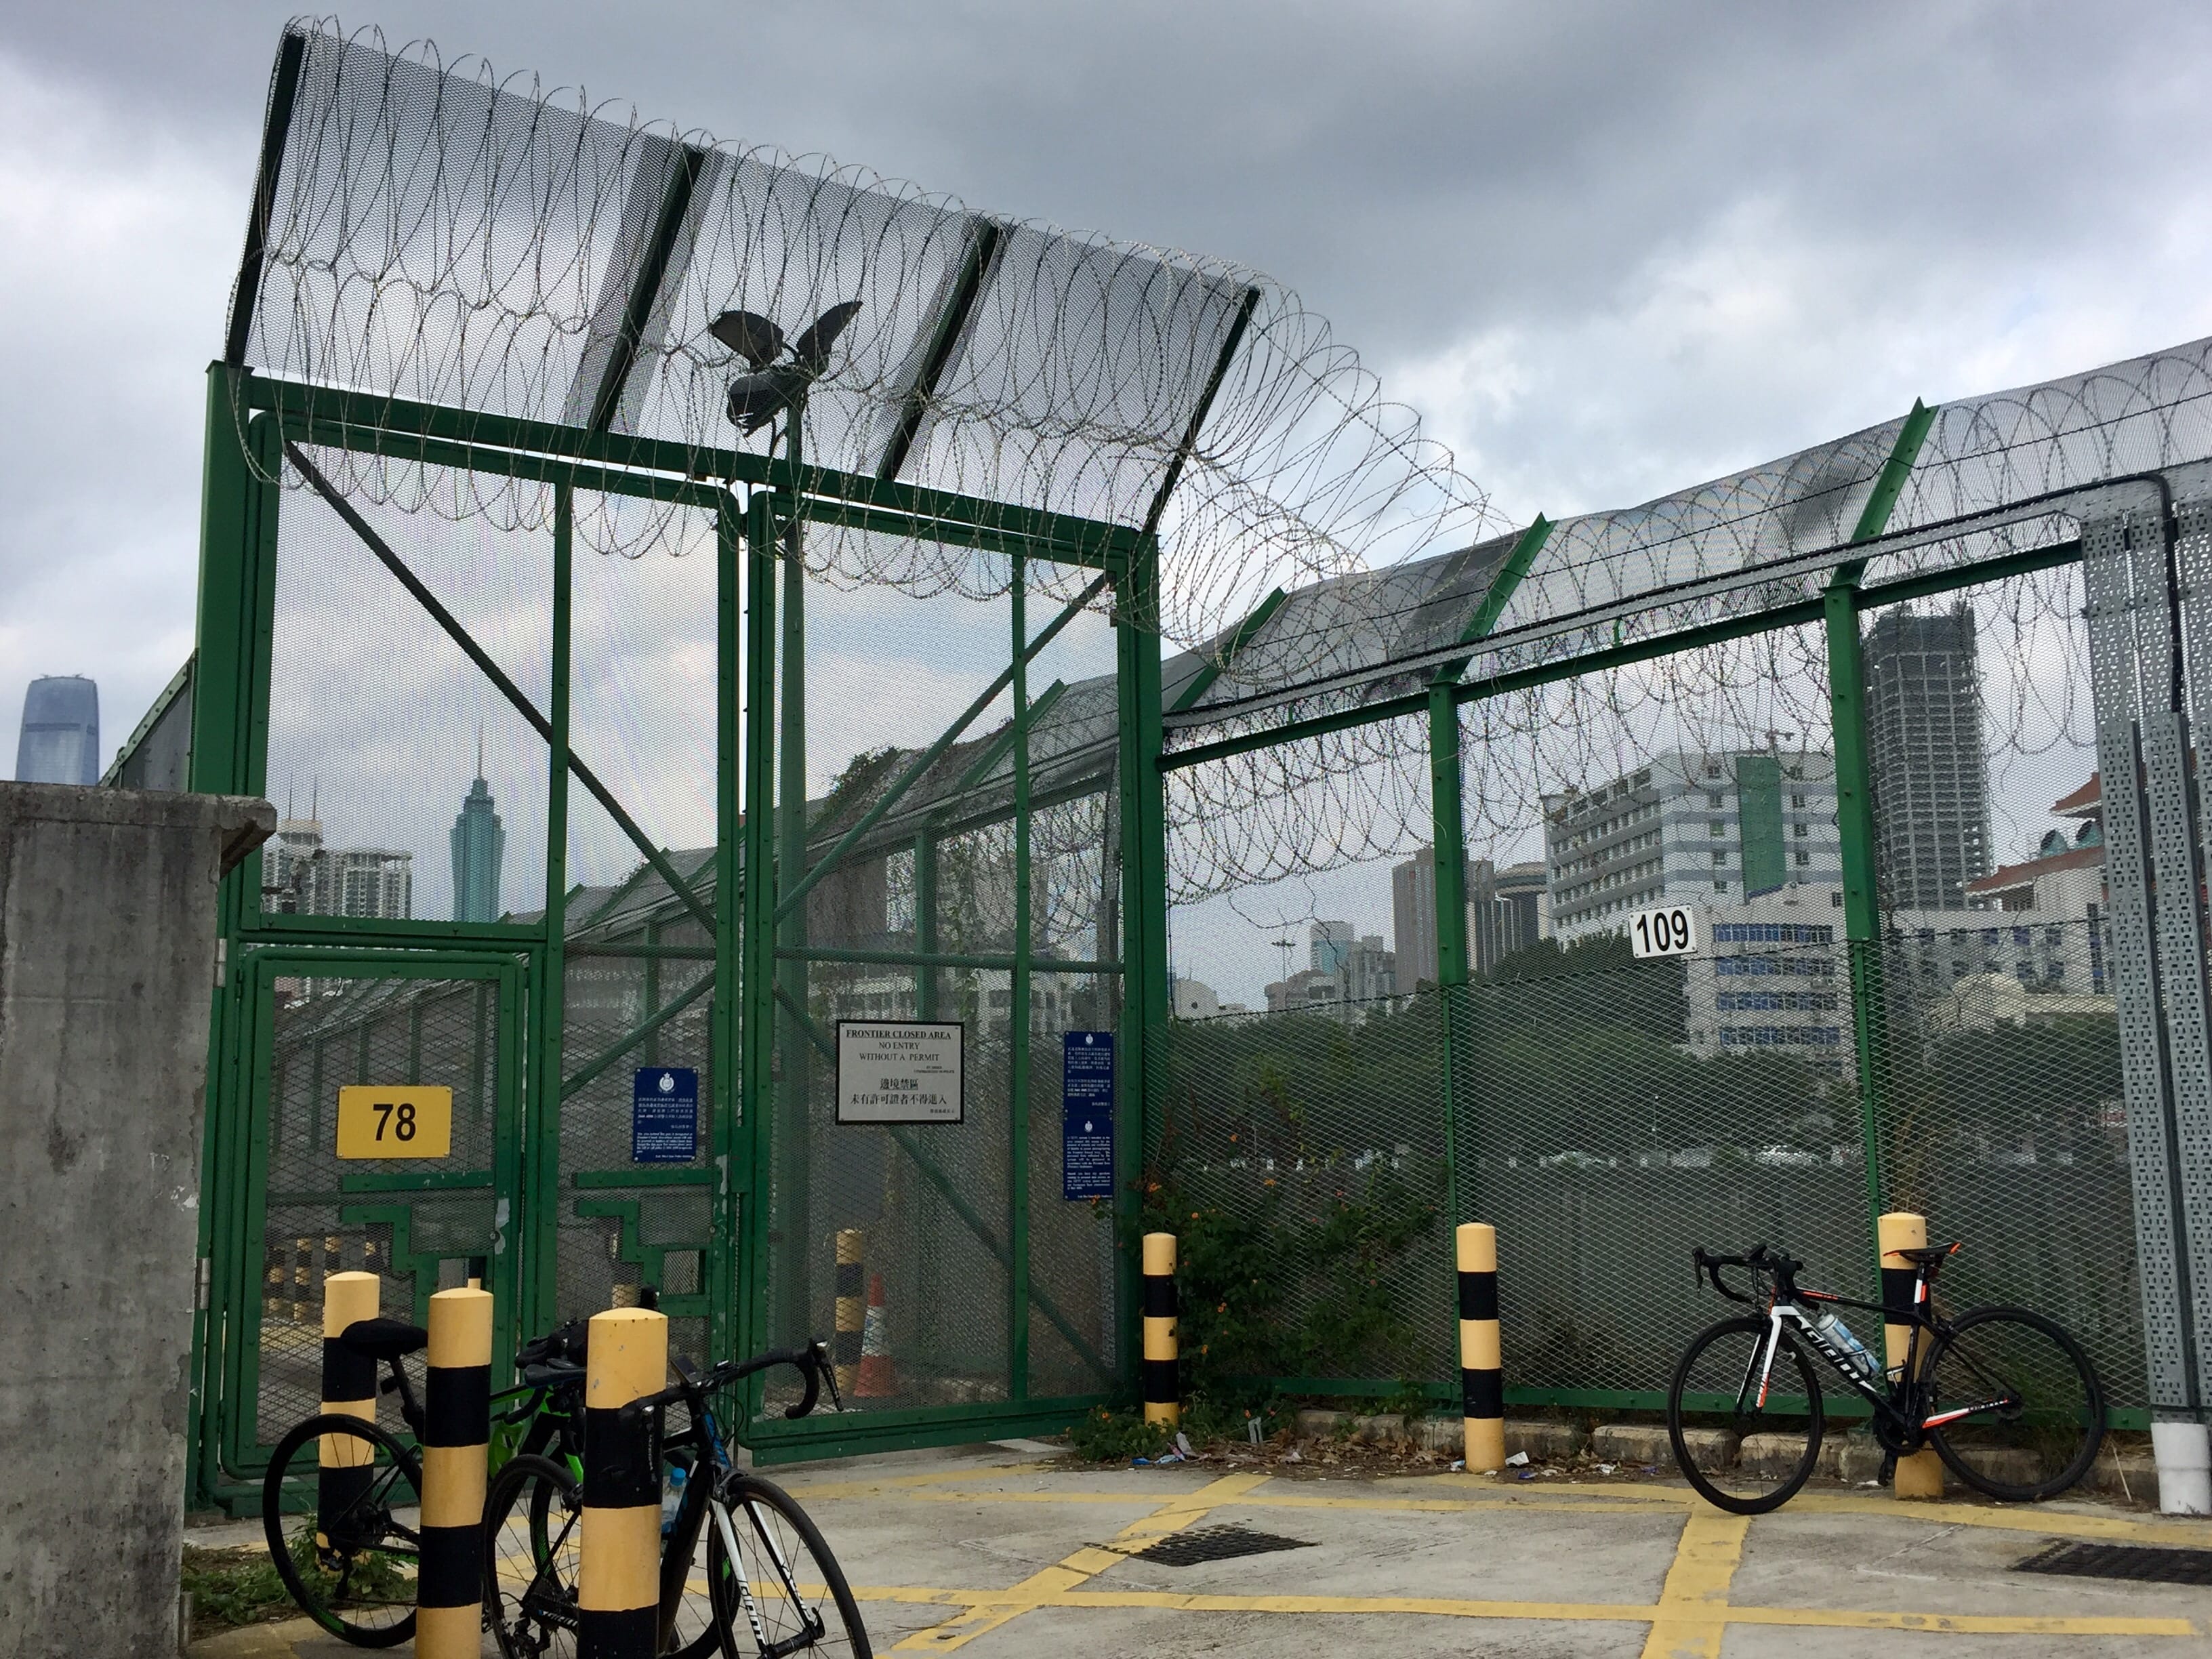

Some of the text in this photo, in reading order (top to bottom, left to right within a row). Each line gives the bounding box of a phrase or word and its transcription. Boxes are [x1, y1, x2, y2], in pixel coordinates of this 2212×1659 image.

[1637, 909, 1689, 953] 109
[846, 1029, 951, 1040] FRONTIER CLOSED AREA
[879, 1042, 920, 1050] NO ENTRY
[859, 1052, 898, 1061] WITHOUT
[909, 1053, 940, 1061] PERMIT
[880, 1078, 919, 1090] 邊境禁區
[851, 1093, 947, 1105] 未有許可證者不得進入
[373, 1103, 416, 1141] 78
[737, 1580, 767, 1646] GIANT
